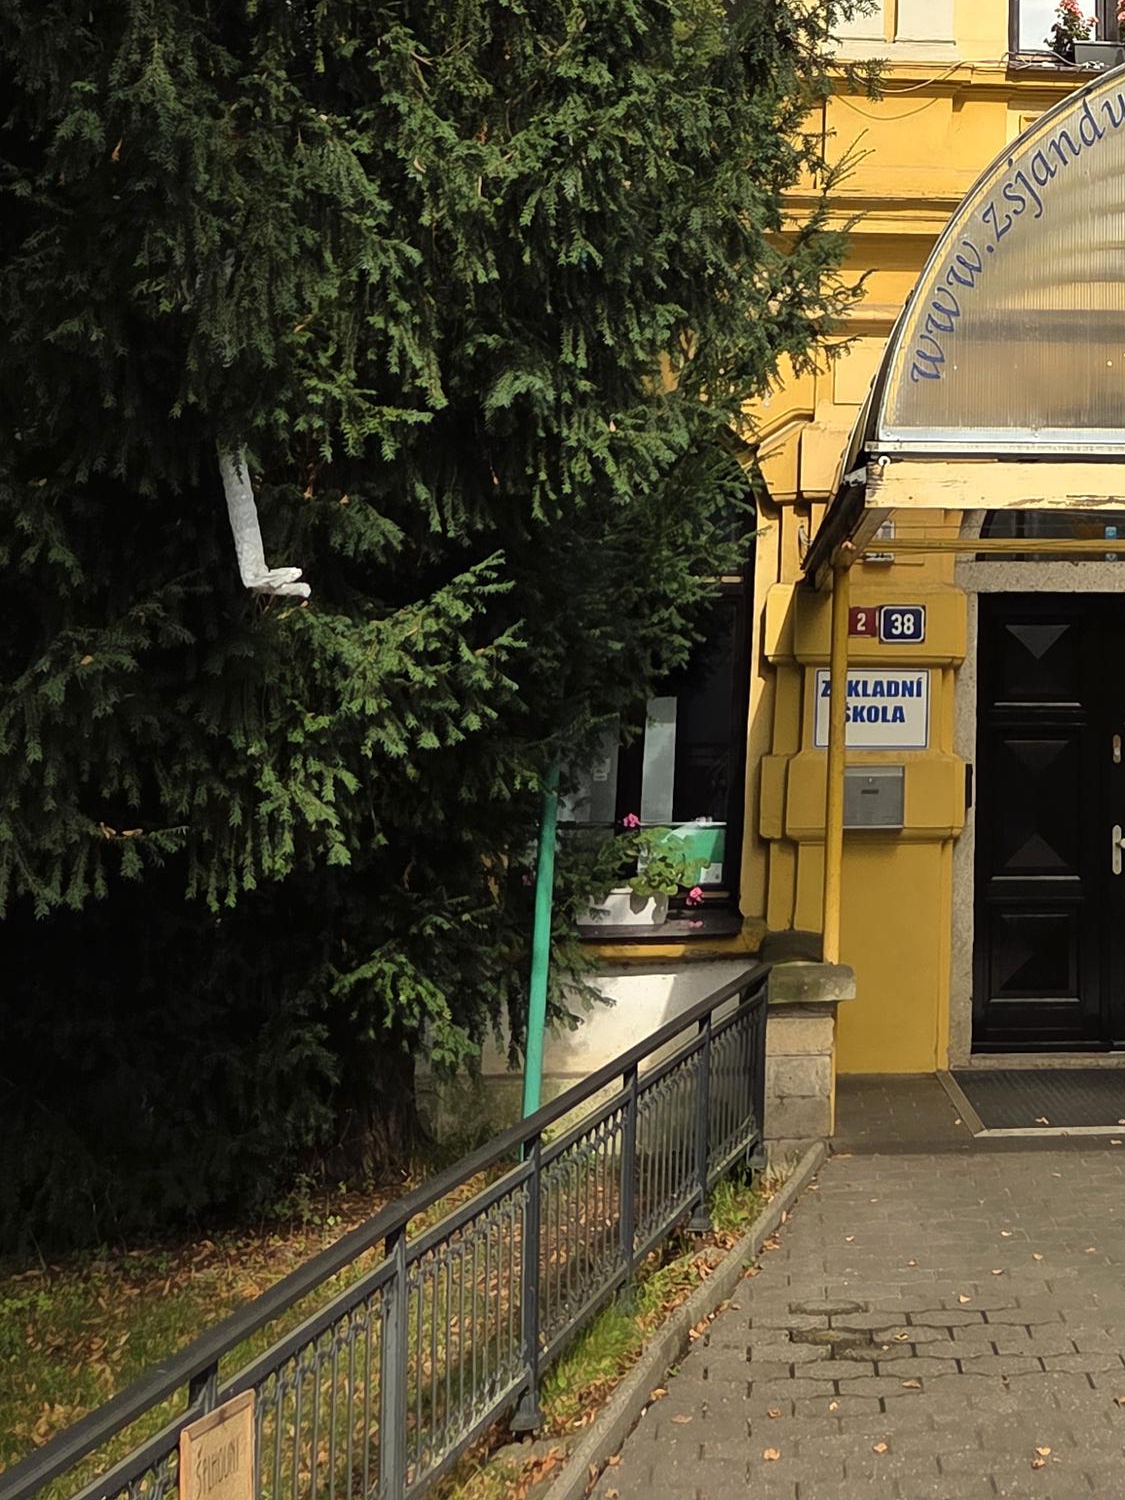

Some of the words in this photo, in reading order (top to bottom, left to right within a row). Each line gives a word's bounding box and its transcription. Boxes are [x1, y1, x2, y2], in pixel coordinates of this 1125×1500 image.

[856, 612, 867, 631] 2
[890, 613, 915, 636] 38
[820, 676, 923, 698] ZKLADNÍ
